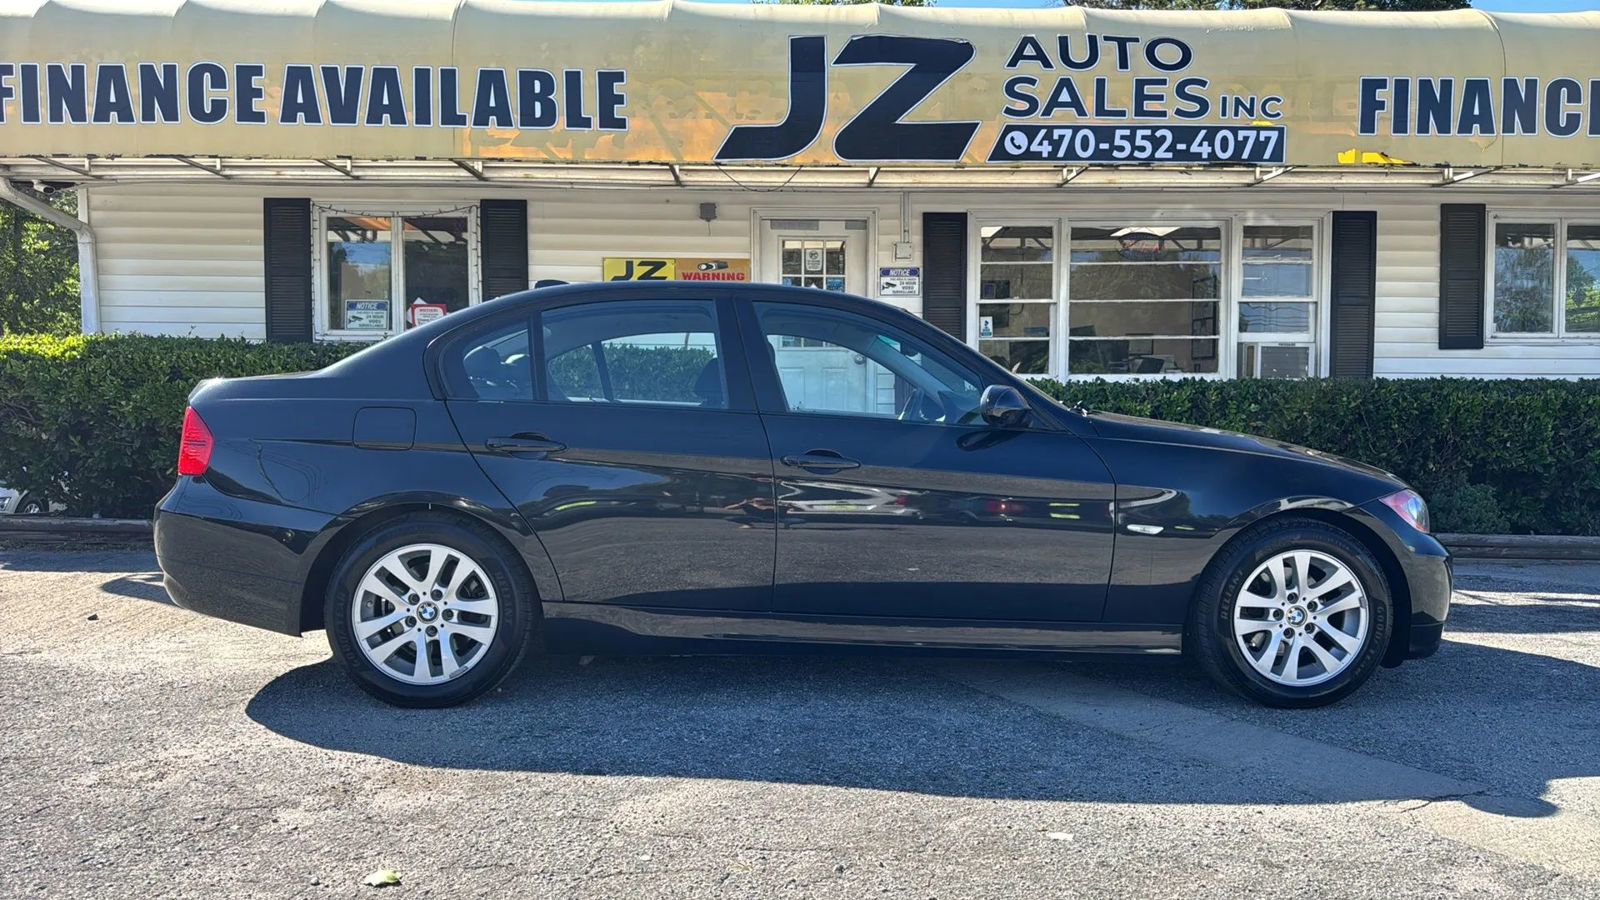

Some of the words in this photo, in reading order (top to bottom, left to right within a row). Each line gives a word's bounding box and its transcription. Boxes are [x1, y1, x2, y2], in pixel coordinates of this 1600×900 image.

[1005, 33, 1193, 71] AUTO
[0, 63, 267, 125] FINANCE
[279, 64, 628, 131] AVAILABLE
[713, 34, 982, 162] JZ
[1002, 76, 1210, 119] SALES
[1220, 95, 1284, 119] INC
[1029, 126, 1280, 160] 470-552-4077
[611, 260, 669, 280] JZ
[682, 272, 745, 281] WARNING
[356, 302, 377, 310] NOTICE
